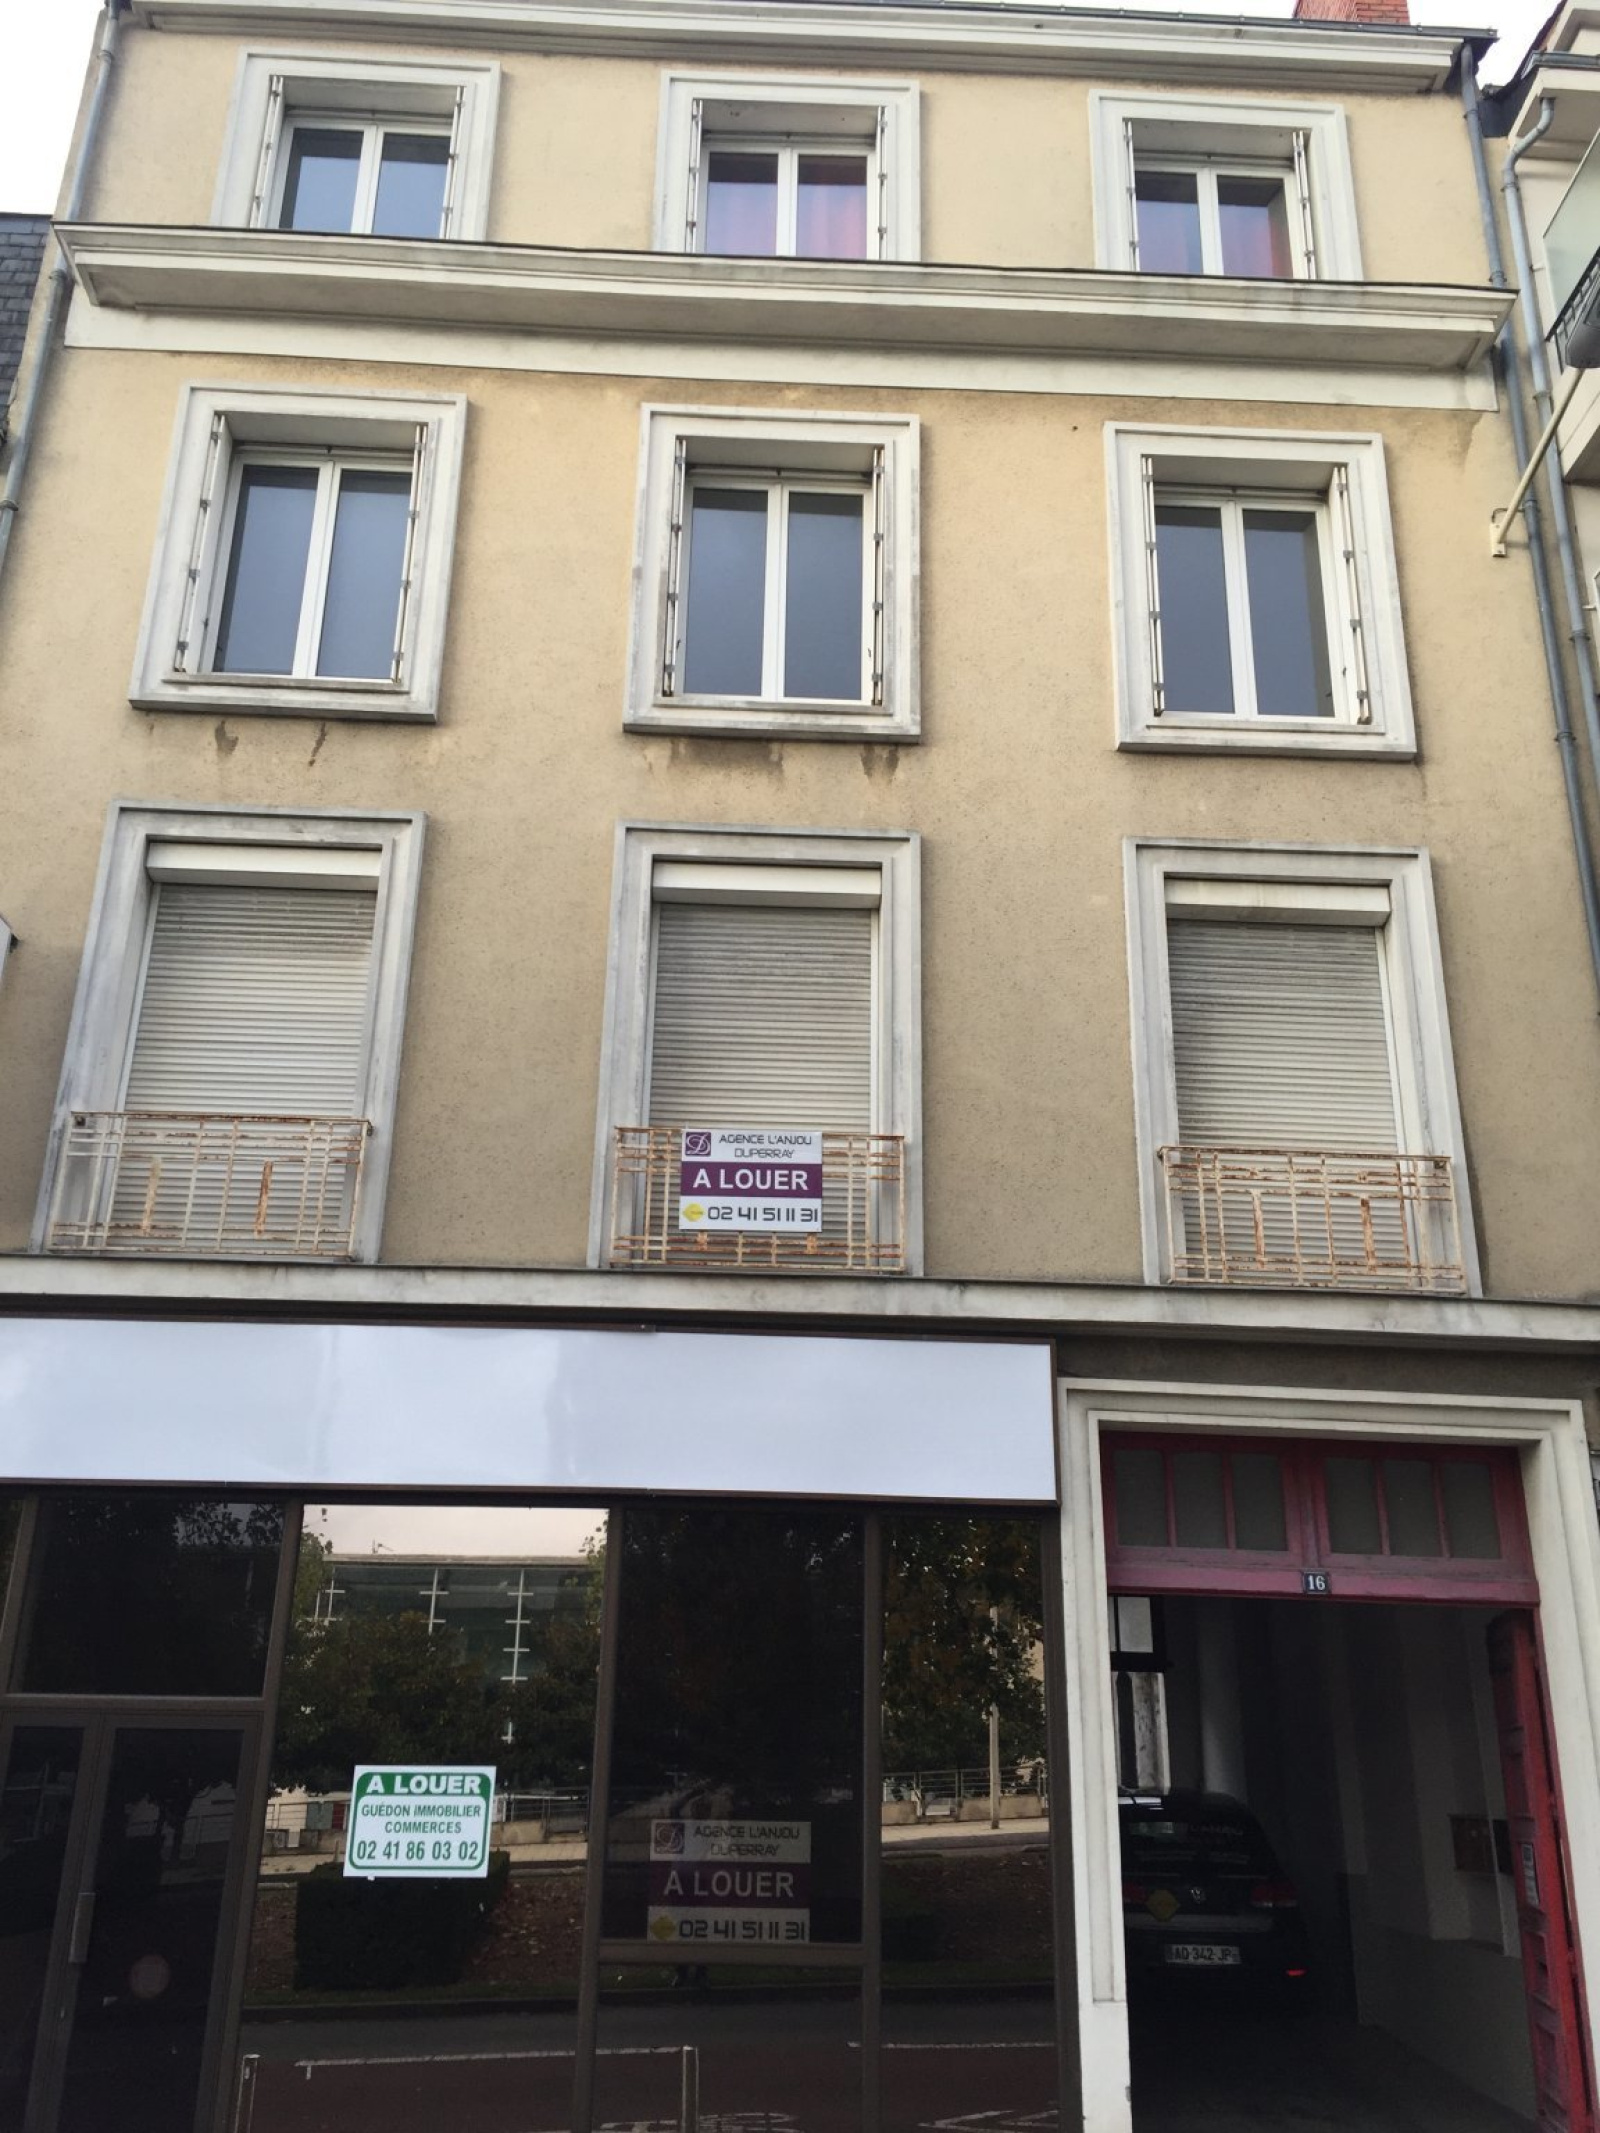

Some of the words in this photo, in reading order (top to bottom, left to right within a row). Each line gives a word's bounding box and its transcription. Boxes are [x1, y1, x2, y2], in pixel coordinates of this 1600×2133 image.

[719, 1134, 764, 1144] AGENCE
[768, 1135, 812, 1145] L'ANJOU
[734, 1148, 795, 1158] DUPERRAY
[693, 1168, 711, 1188] A
[719, 1169, 809, 1190] LOUER
[708, 1206, 733, 1220] 02
[738, 1207, 757, 1221] 41
[762, 1208, 781, 1222] 51
[786, 1208, 795, 1222] 11
[801, 1208, 818, 1222] 31
[1308, 1575, 1326, 1590] 16
[366, 1775, 385, 1794] A
[394, 1775, 482, 1795] LOUER
[361, 1802, 410, 1817] GUÉDON
[414, 1804, 481, 1817] IMMOBILIER
[385, 1821, 461, 1834] COMMERCES
[694, 1825, 744, 1838] AGENCE
[750, 1826, 800, 1839] L'ANJOU
[357, 1840, 376, 1860] 02
[383, 1840, 400, 1860] 41
[406, 1841, 425, 1860] 86
[432, 1841, 451, 1860] 03
[458, 1841, 478, 1860] 02
[710, 1844, 779, 1856] DUPERRAY
[663, 1870, 684, 1895] A
[694, 1871, 794, 1897] LOUER
[679, 1920, 708, 1938] 02
[713, 1920, 735, 1939] 41
[742, 1921, 763, 1939] 51
[769, 1922, 779, 1940] 11
[785, 1922, 805, 1940] 31
